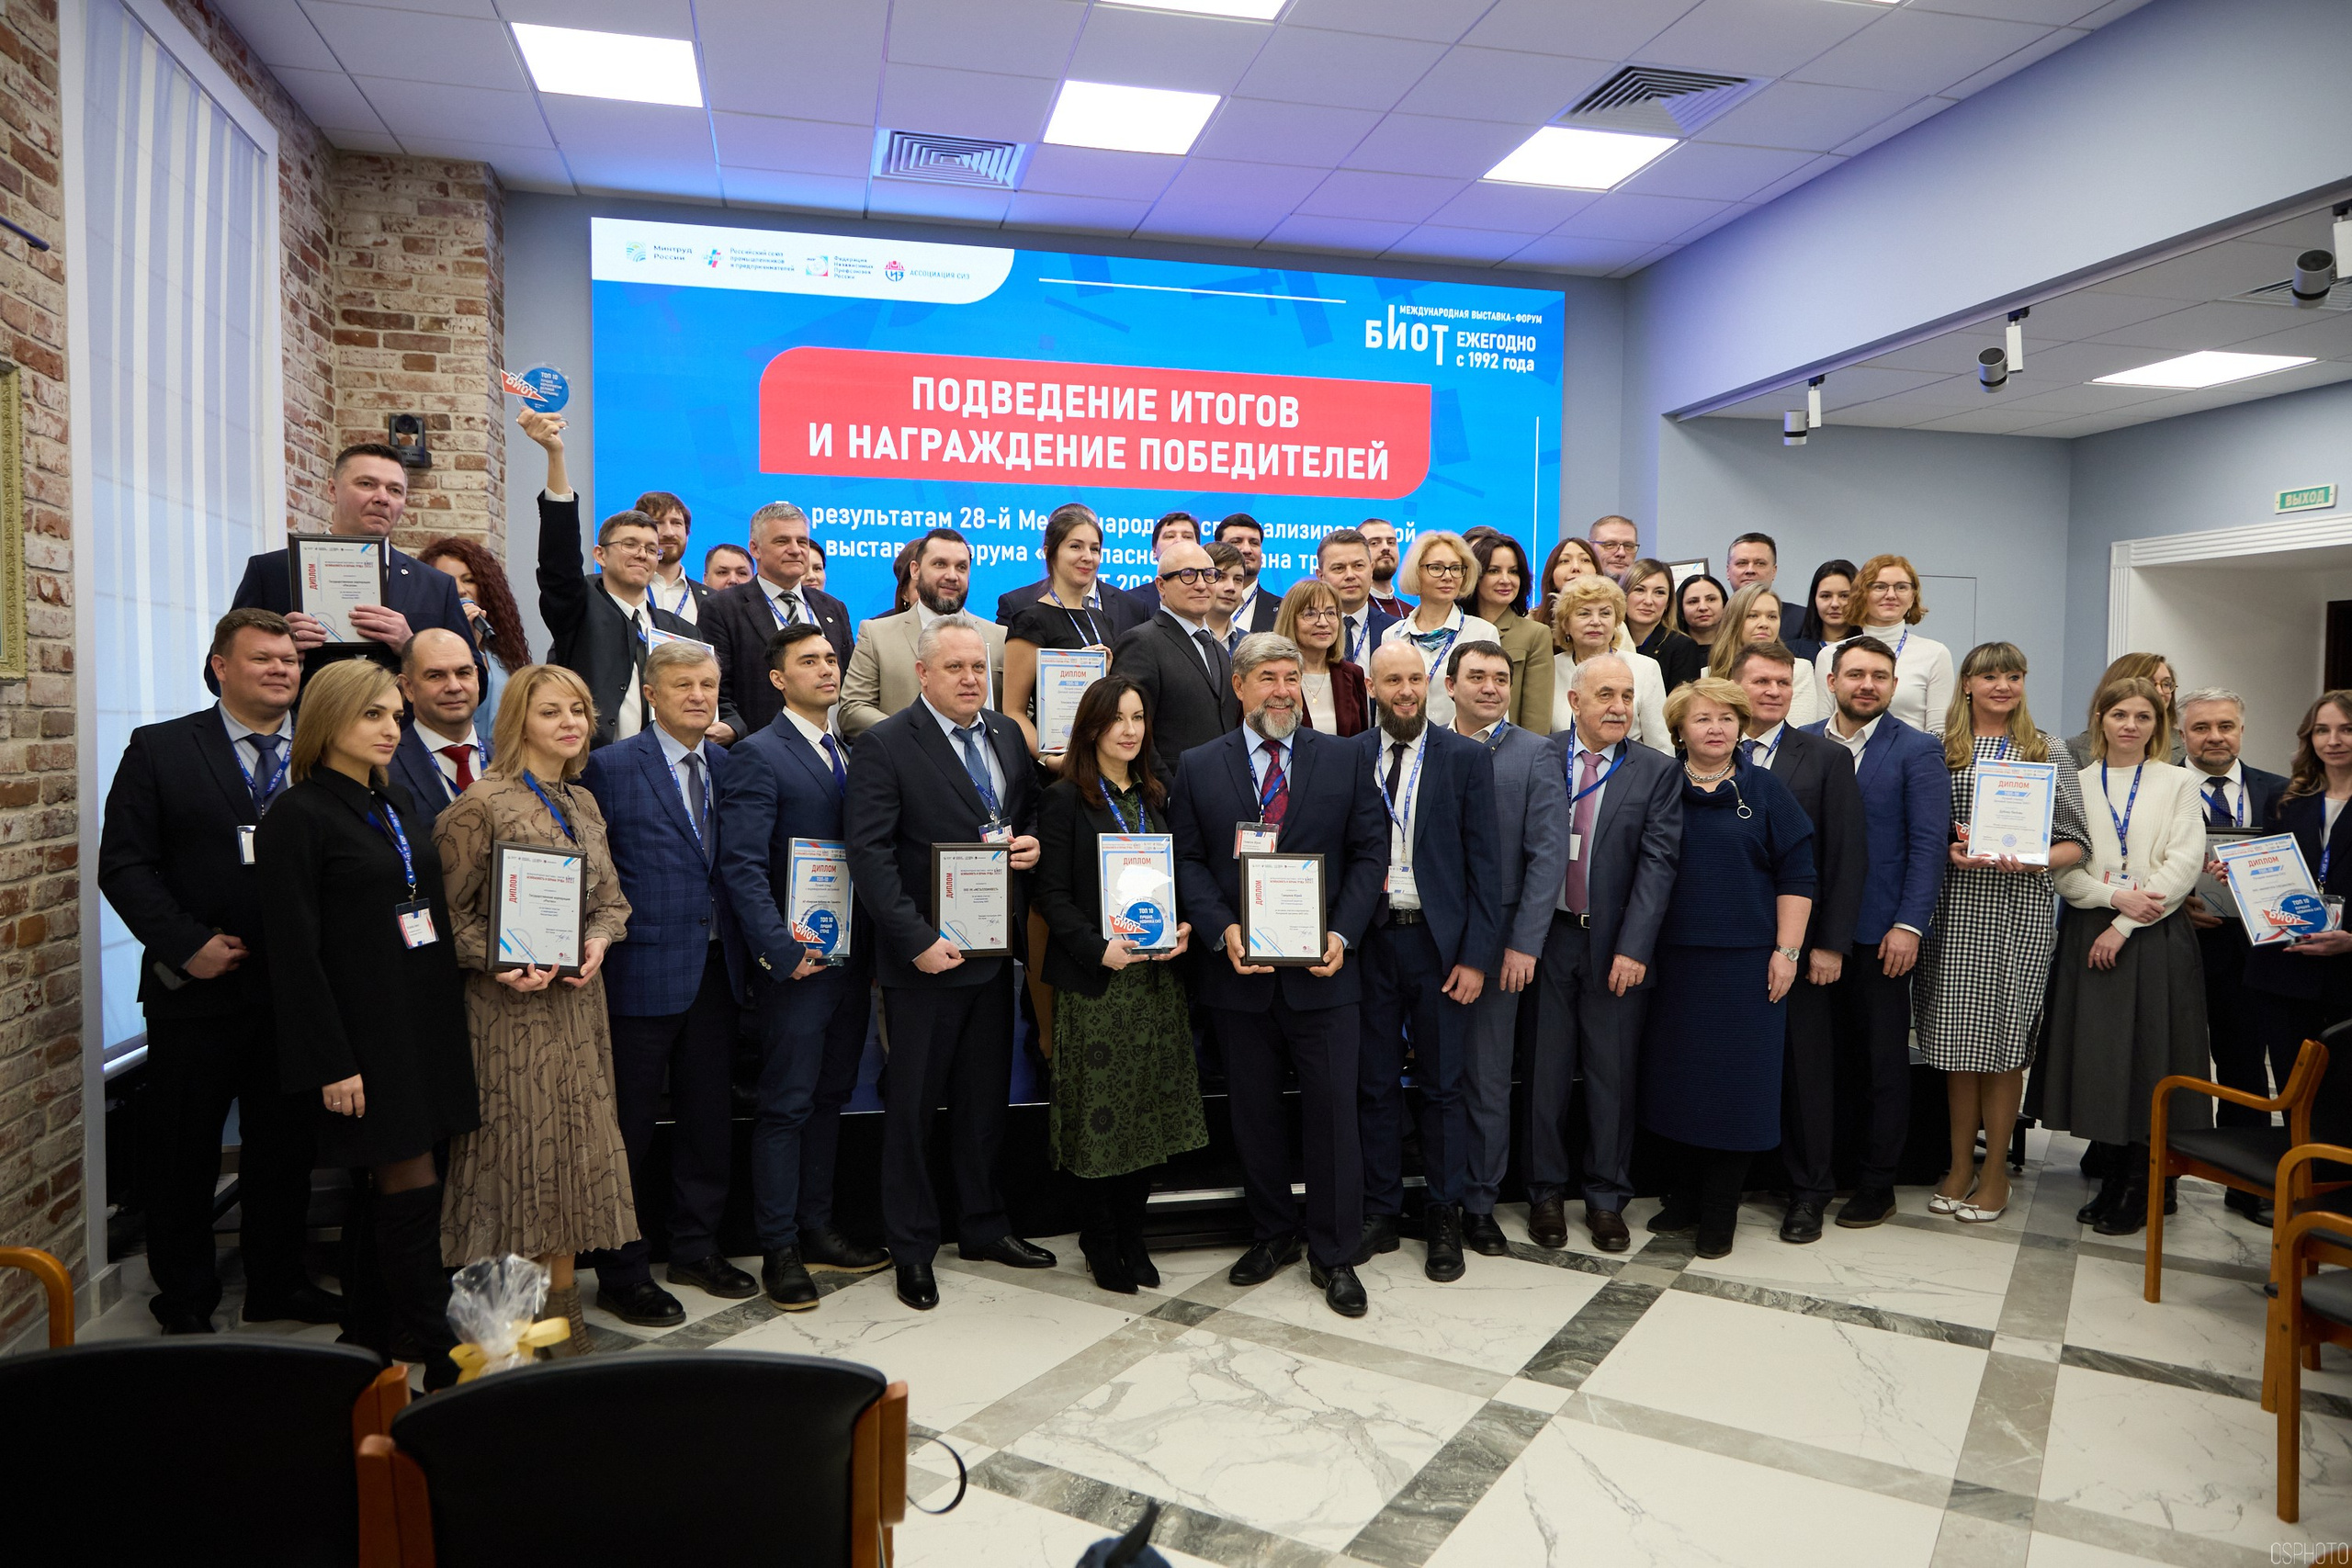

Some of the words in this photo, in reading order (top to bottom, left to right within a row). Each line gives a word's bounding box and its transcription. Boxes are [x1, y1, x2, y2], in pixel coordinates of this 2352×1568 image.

[653, 245, 693, 254] Минтруд
[910, 270, 956, 279] АССОЦИАЦИЯ
[1400, 305, 1469, 319] МЕЖДУНАРОДНАЯ
[1472, 310, 1543, 324] ВЫСТАВКА-ФОРУМ
[1365, 304, 1449, 366] БИОТ
[1456, 331, 1536, 354] ЕЖЕГОДНО
[1456, 355, 1464, 367] с
[1468, 351, 1499, 369] 1992
[1503, 357, 1535, 373] года
[505, 372, 536, 398] БИОТ
[912, 376, 1158, 422] ПОДВЕДЕНИЕ
[1170, 389, 1300, 428] ИТОГОВ
[809, 423, 832, 457] И
[848, 424, 1126, 471] НАГРАЖДЕНИЕ
[1139, 435, 1389, 480] ПОБЕДИТЕЛЕЙ
[2285, 489, 2325, 507] ВЫХОД
[811, 506, 952, 530] результатам
[960, 506, 1011, 530] 28-й
[309, 563, 318, 590] ДИПЛОМ
[1998, 780, 2030, 789] ДИПЛОМ
[811, 864, 837, 873] ДИПЛОМ
[1123, 857, 1151, 866] ДИПЛОМ
[2247, 856, 2279, 867] ДИПЛОМ
[509, 874, 517, 904] ДИПЛОМ
[1255, 880, 1263, 906] ДИПЛОМ
[1114, 913, 1139, 933] БИОТ
[2269, 906, 2301, 925] БИОТ
[795, 920, 818, 942] БИОТ
